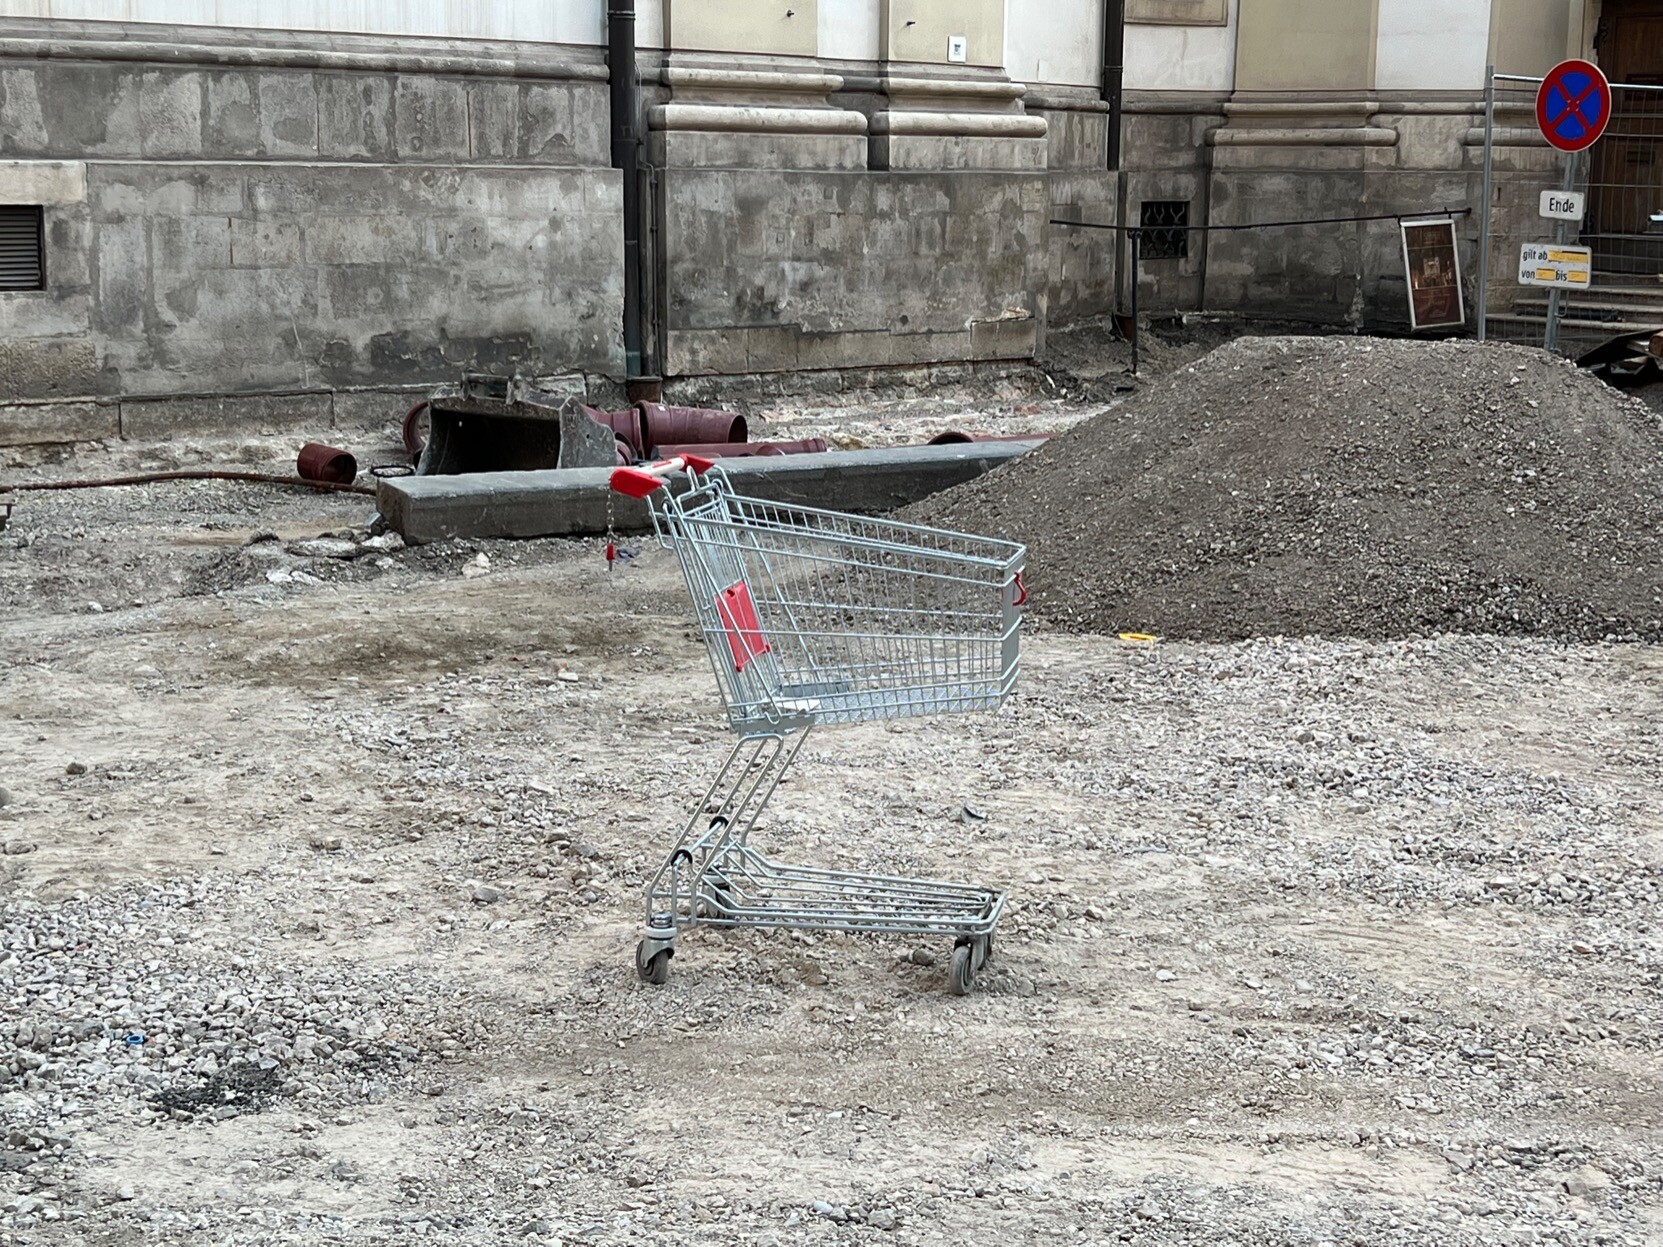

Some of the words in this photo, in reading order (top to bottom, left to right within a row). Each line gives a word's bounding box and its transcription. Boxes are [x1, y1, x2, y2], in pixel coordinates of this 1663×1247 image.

[1549, 197, 1575, 213] Ende
[1523, 249, 1537, 261] gilt
[1538, 251, 1548, 261] ab
[1521, 270, 1535, 279] von
[1555, 269, 1567, 281] bis
